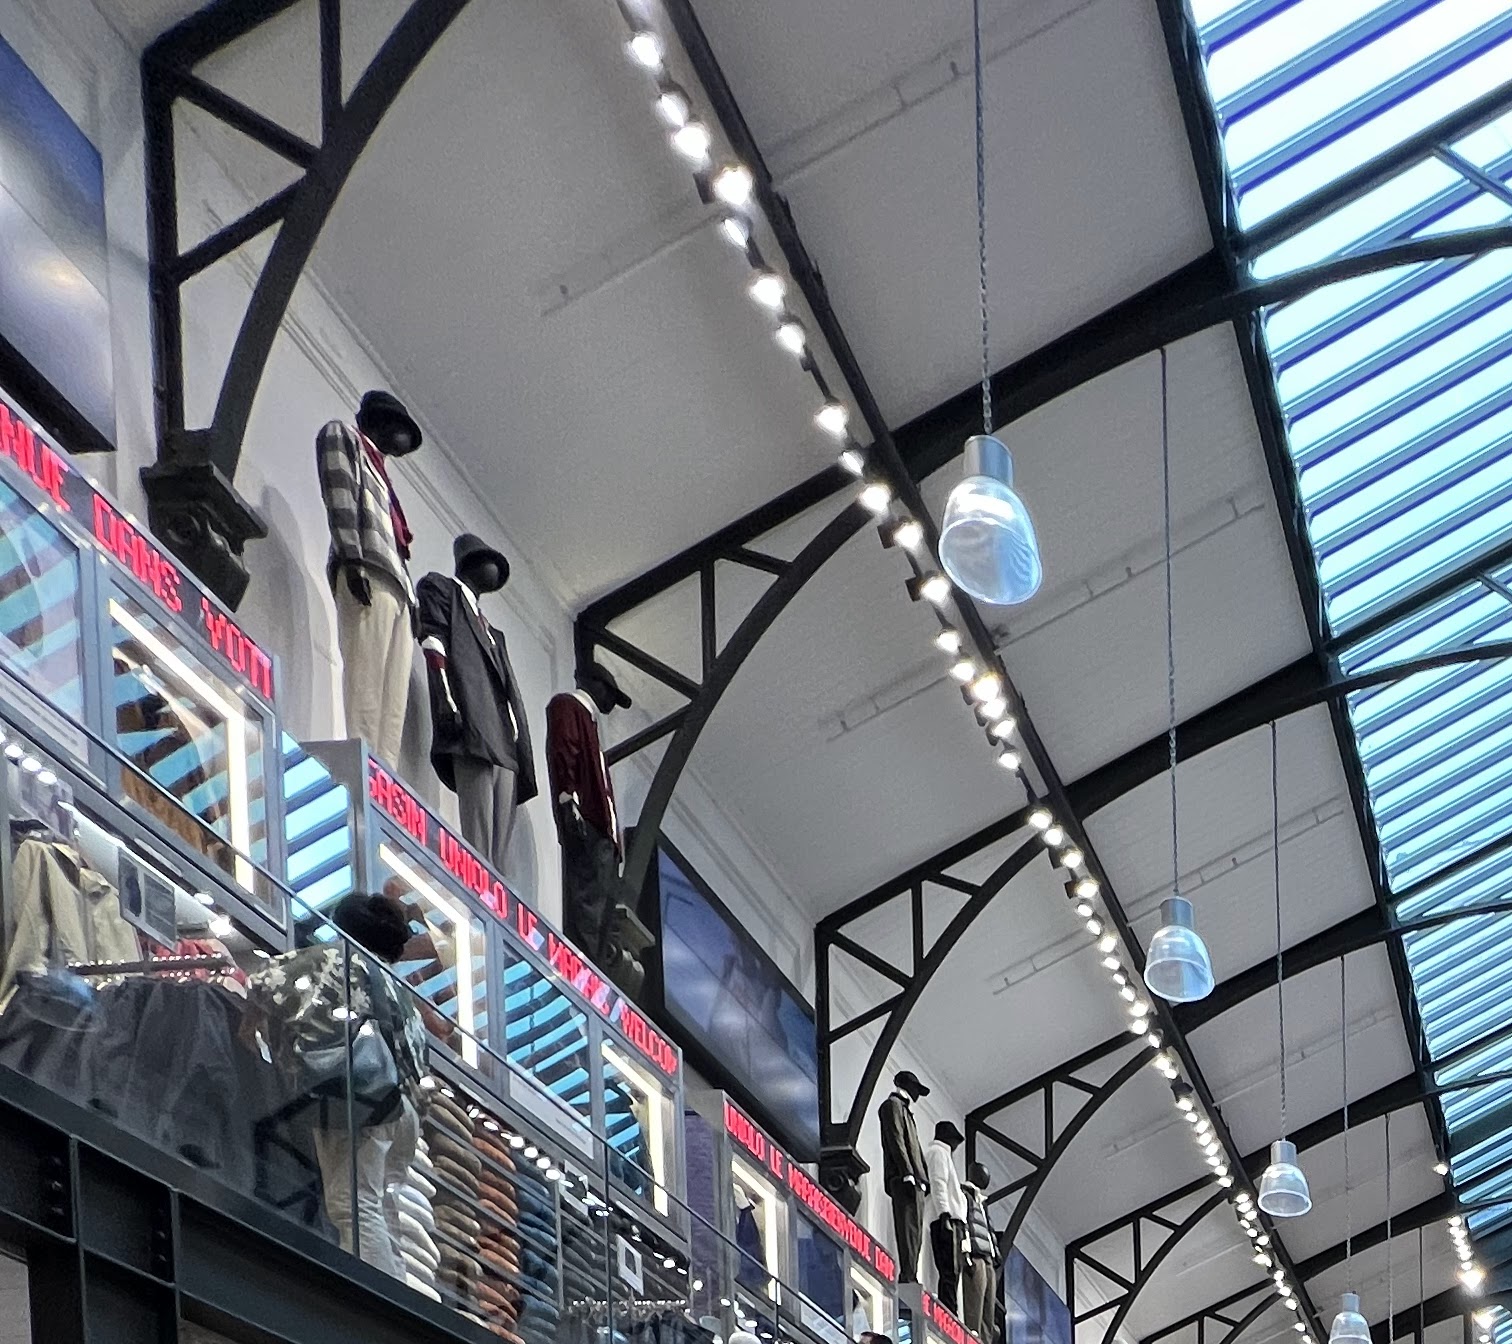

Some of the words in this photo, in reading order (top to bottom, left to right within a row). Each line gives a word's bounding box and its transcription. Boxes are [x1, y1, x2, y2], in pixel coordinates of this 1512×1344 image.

[93, 493, 183, 613] DANS
[438, 827, 508, 920] UNIQLO
[769, 1138, 784, 1180] LE
